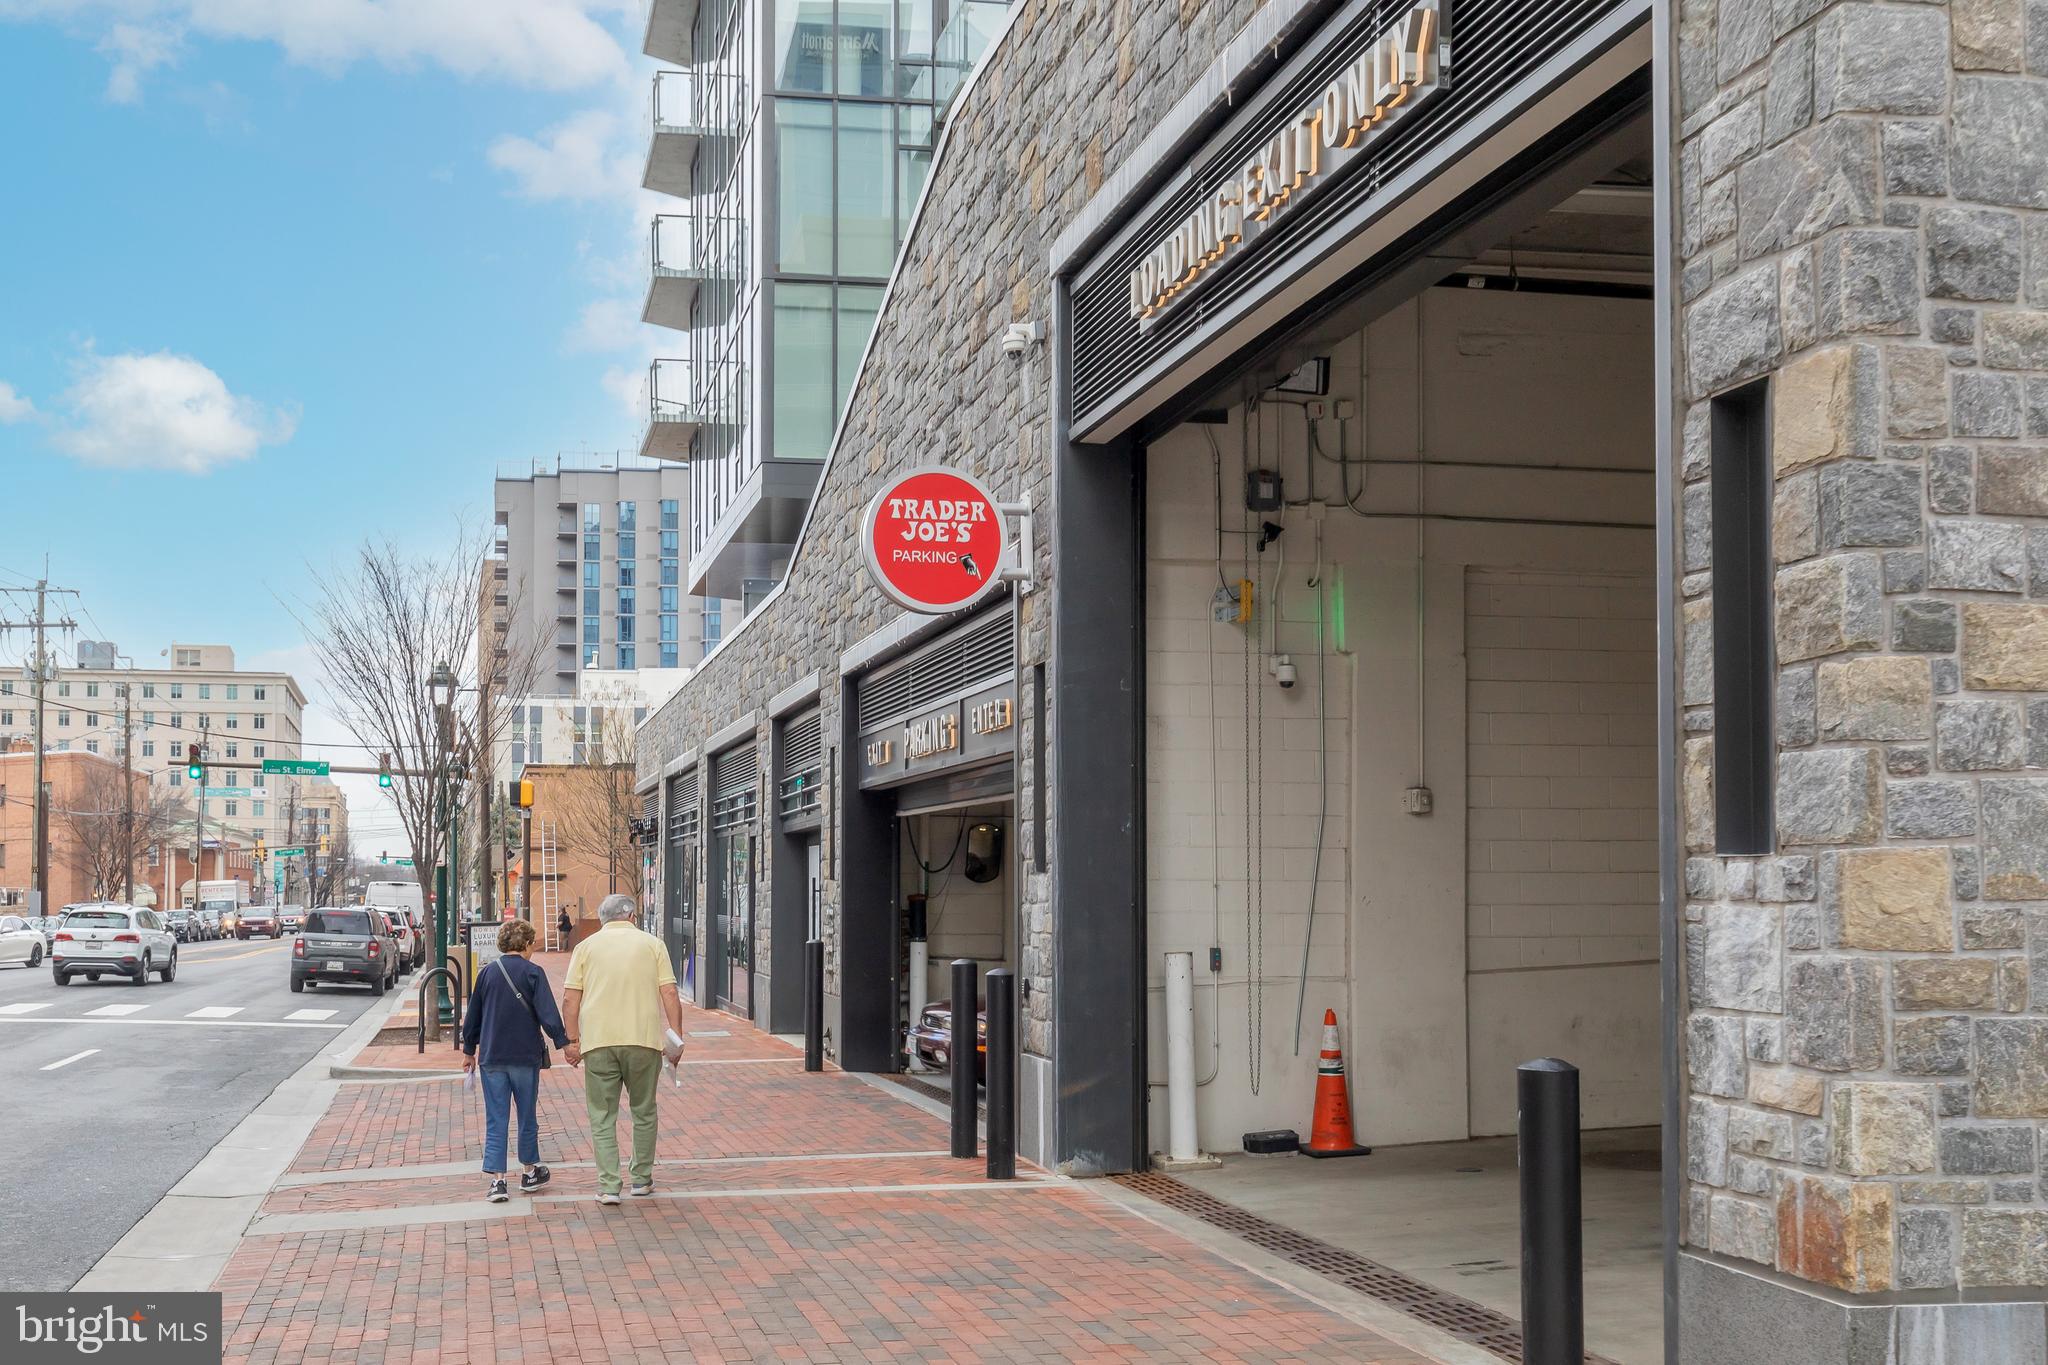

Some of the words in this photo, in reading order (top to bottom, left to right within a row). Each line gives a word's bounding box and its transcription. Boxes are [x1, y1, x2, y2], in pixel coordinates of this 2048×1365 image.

[1130, 181, 1238, 319] LOADING
[1243, 109, 1316, 219] EXIT
[1322, 9, 1422, 148] ONLY
[888, 498, 987, 522] TRADER
[900, 521, 974, 543] JOE'S
[893, 549, 958, 564] PARKING
[971, 698, 1004, 734] ENTER
[904, 714, 951, 759] PARKING
[867, 741, 885, 766] EXIT
[282, 766, 293, 774] St.
[296, 766, 317, 775] Elmo
[473, 932, 496, 940] LUXUR
[474, 939, 496, 947] APART
